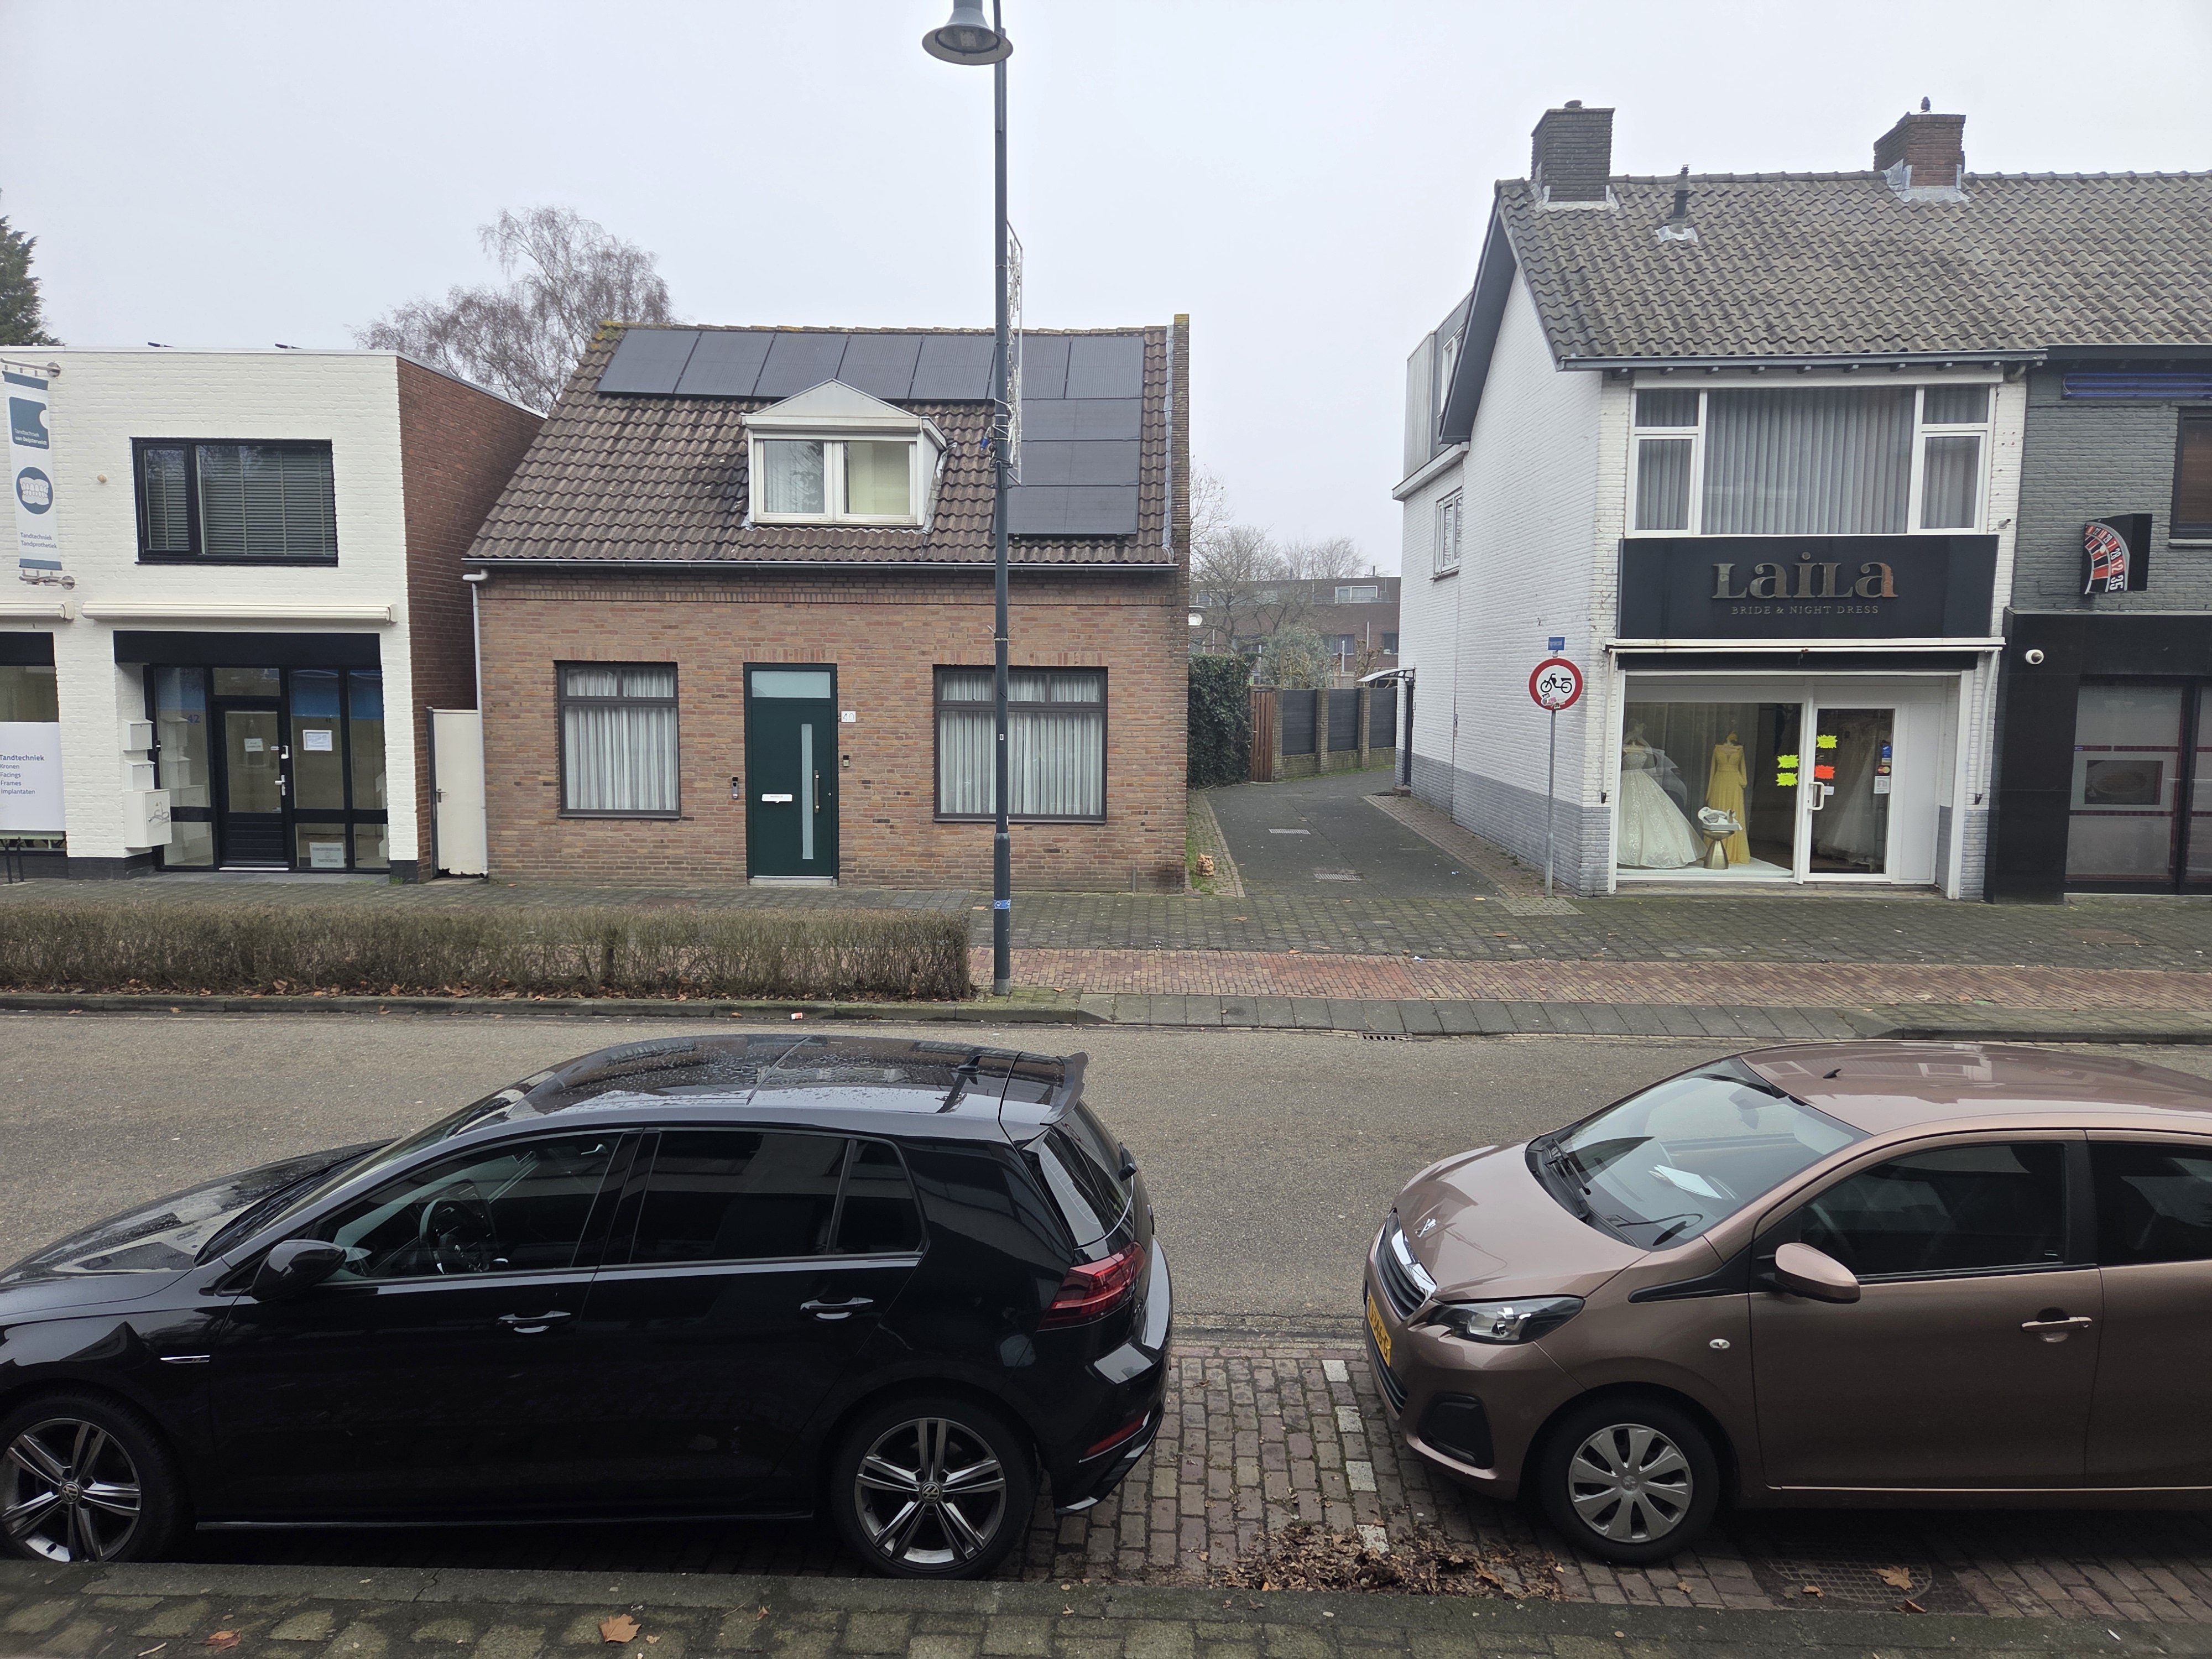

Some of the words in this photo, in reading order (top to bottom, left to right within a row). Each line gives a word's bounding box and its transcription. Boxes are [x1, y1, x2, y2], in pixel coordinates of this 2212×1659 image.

[20, 532, 52, 540] Tandtechniek
[21, 540, 58, 549] Tandprothetiek
[2107, 540, 2117, 549] 7
[2110, 547, 2121, 560] 28
[2111, 559, 2124, 573] 12
[2109, 575, 2124, 591] 35
[1731, 606, 1771, 614] BRIDE
[1789, 606, 1832, 614] NIGHT
[1836, 606, 1879, 614] DRESS
[187, 714, 201, 723] 42
[843, 713, 854, 721] 40
